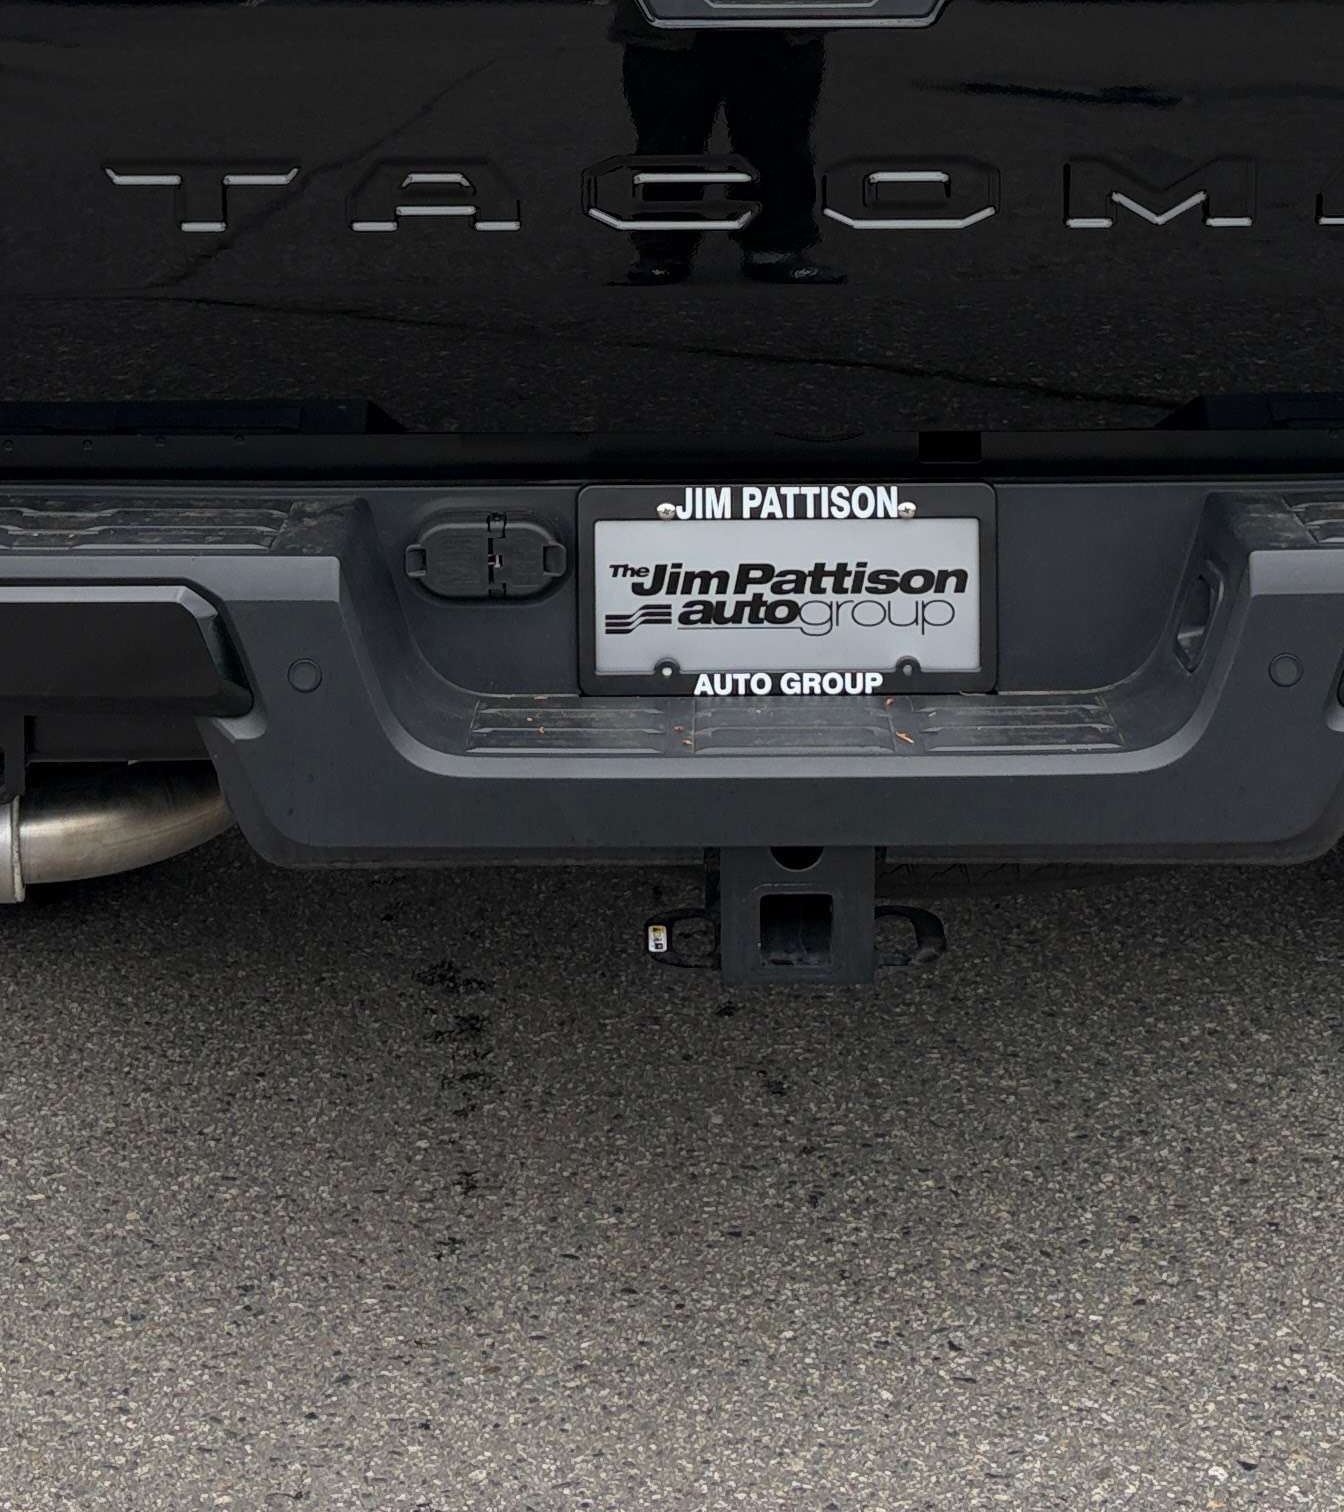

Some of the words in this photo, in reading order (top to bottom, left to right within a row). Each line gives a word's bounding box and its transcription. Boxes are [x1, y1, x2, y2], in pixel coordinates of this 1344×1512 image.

[676, 486, 732, 519] JIM
[742, 485, 898, 519] PATTISON
[608, 563, 650, 579] The
[631, 562, 730, 596] Jim
[733, 561, 969, 595] Pattison
[693, 672, 773, 696] AUTO
[779, 671, 884, 697] GROUP
